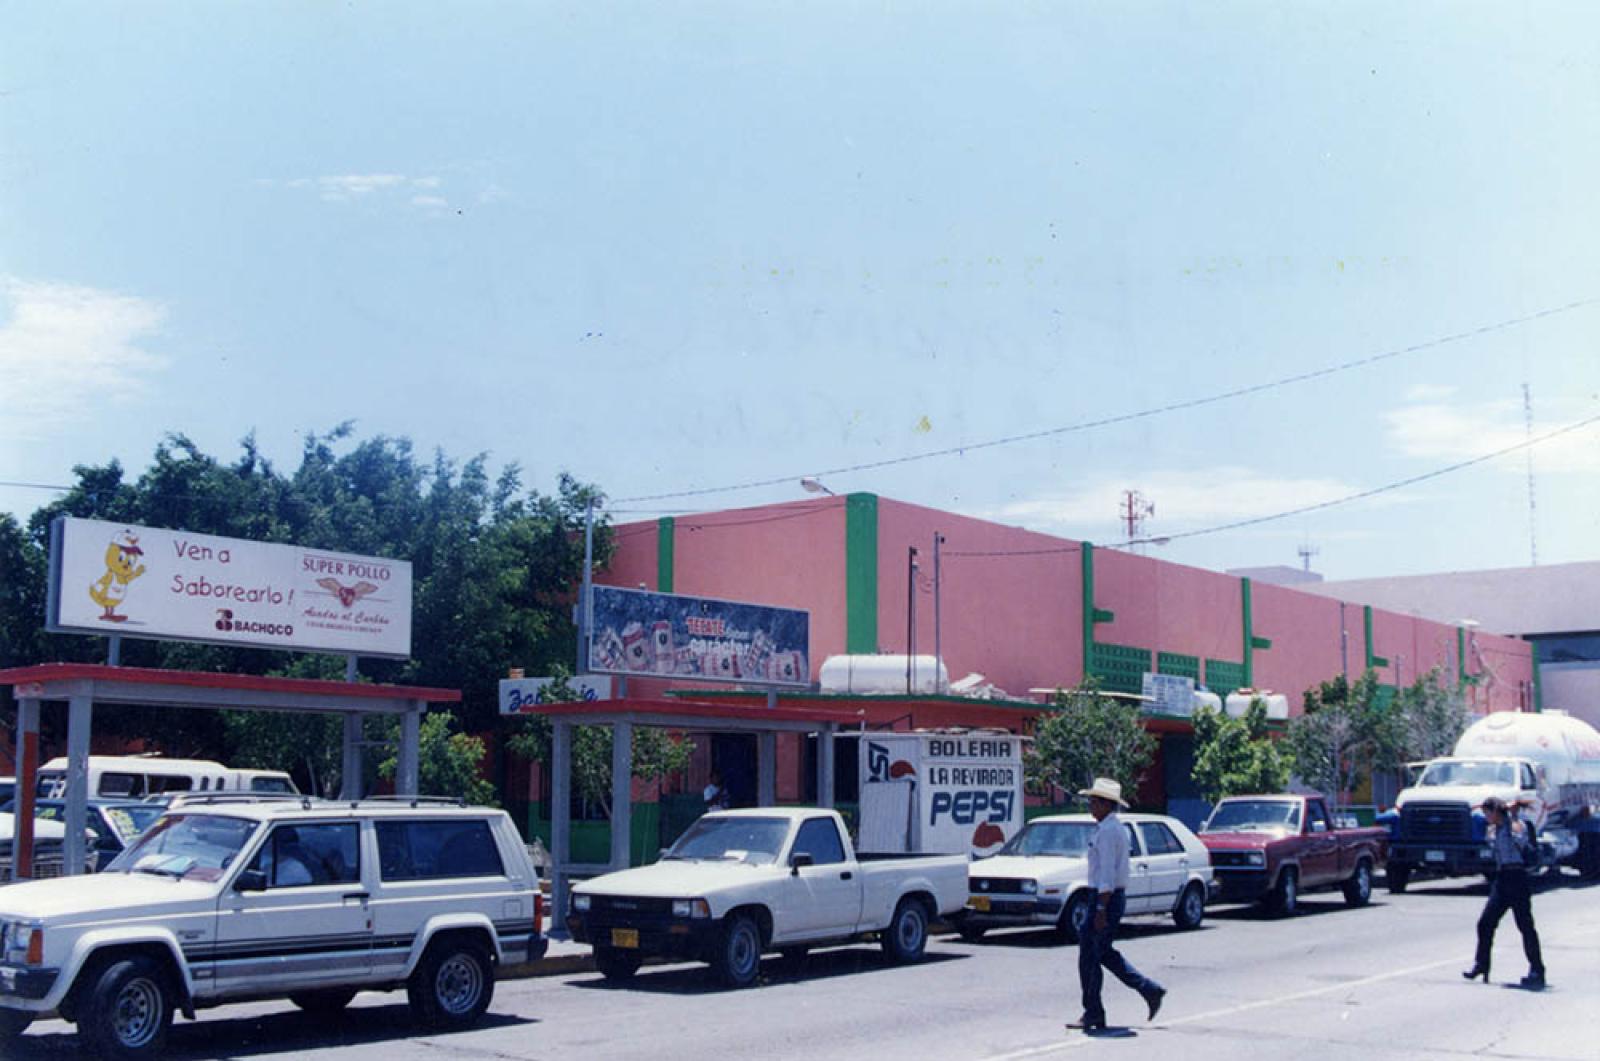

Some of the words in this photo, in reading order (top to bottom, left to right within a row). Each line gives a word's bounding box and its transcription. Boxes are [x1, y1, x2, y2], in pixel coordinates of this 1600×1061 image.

[174, 539, 213, 561] Ven
[217, 549, 231, 564] a
[303, 557, 344, 575] SUPER
[348, 562, 391, 580] POLLO
[170, 574, 283, 605] Saborearlo
[234, 621, 294, 636] BACHOCO
[686, 615, 725, 637] TECATE
[929, 740, 1011, 758] BOLERIA
[929, 767, 949, 786] LA
[952, 767, 1014, 787] REVIRADA
[930, 790, 1015, 827] PEPSI
